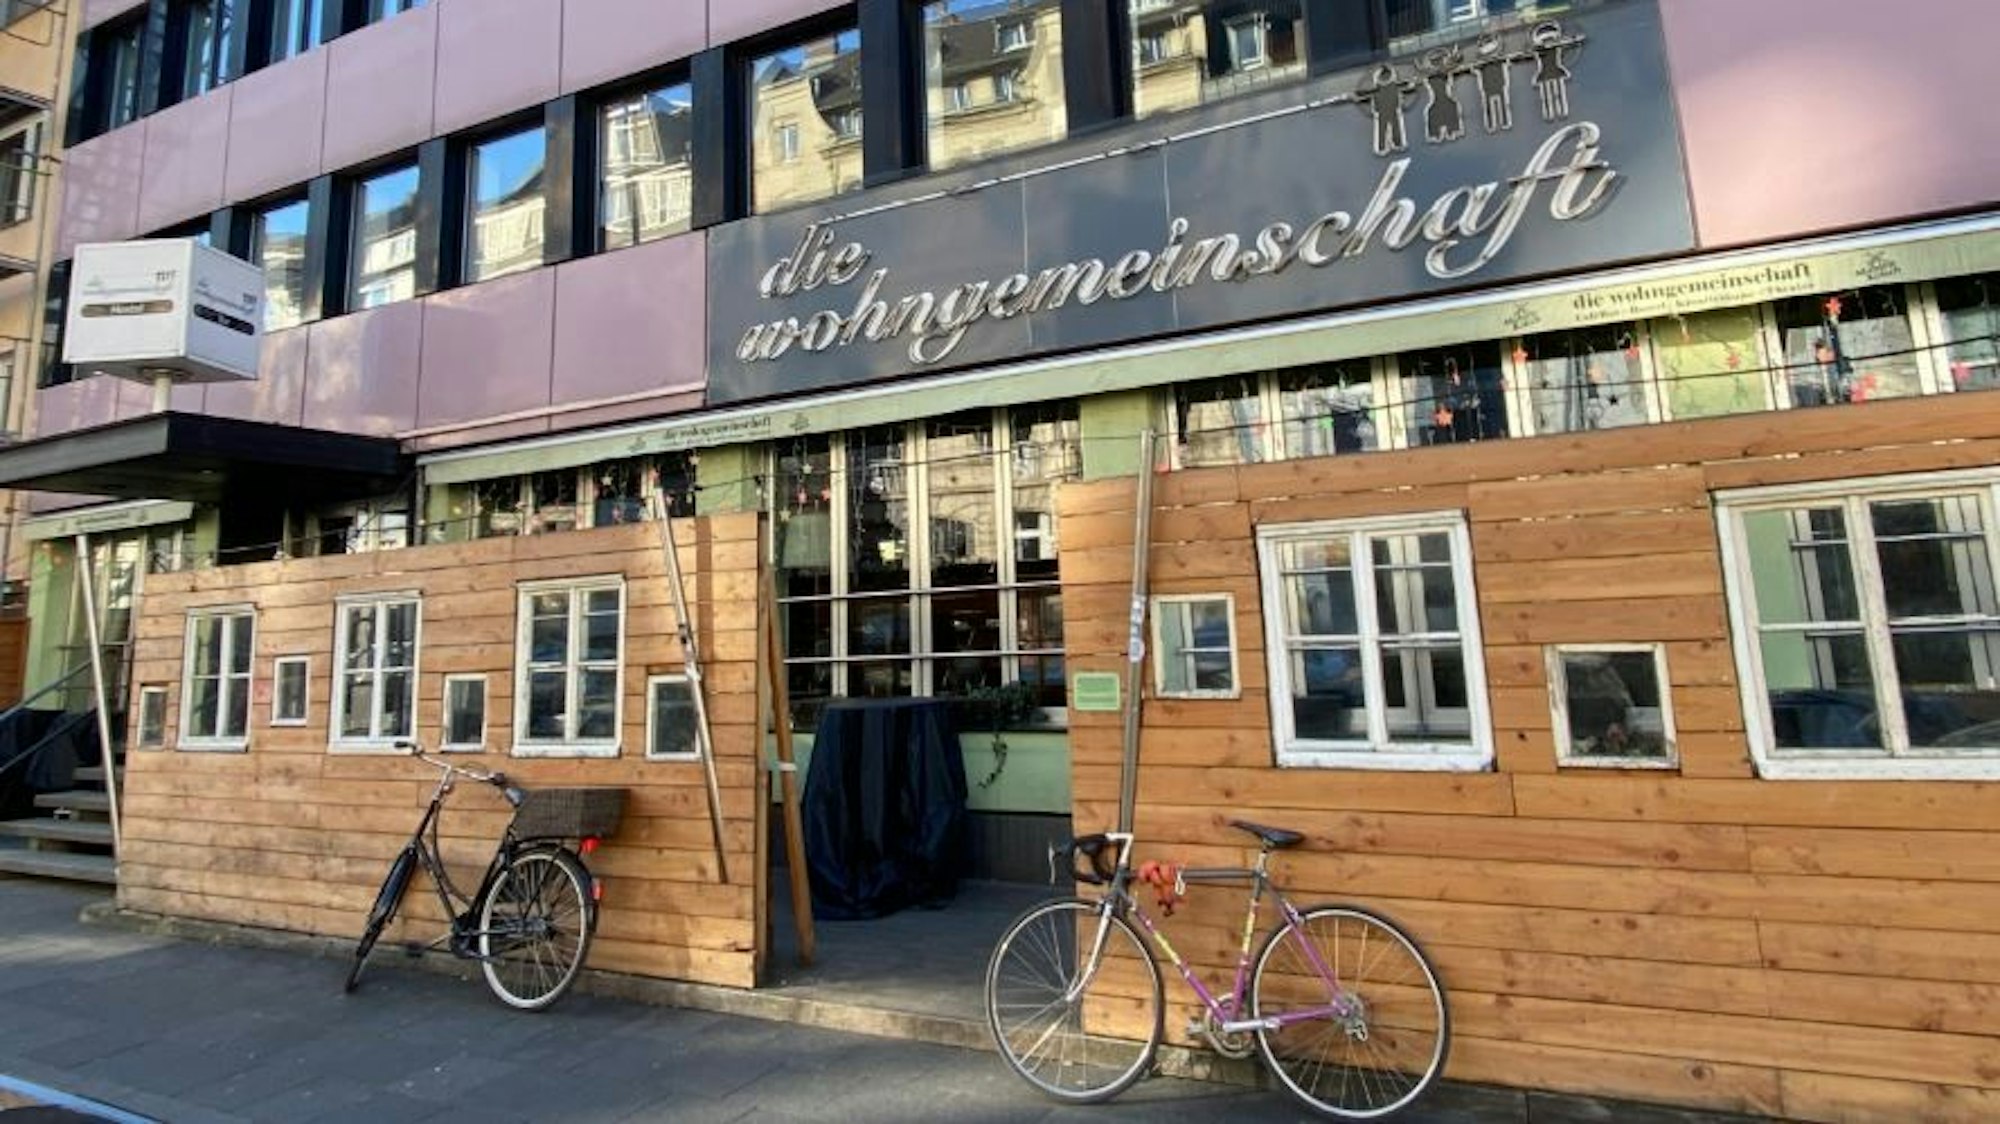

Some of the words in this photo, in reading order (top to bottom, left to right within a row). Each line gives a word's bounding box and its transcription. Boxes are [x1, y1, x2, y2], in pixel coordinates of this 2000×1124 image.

[738, 121, 1618, 366] wohngemeinschaft
[759, 221, 868, 301] die
[1573, 293, 1605, 310] die
[1609, 263, 1811, 305] wohngemeinschaft
